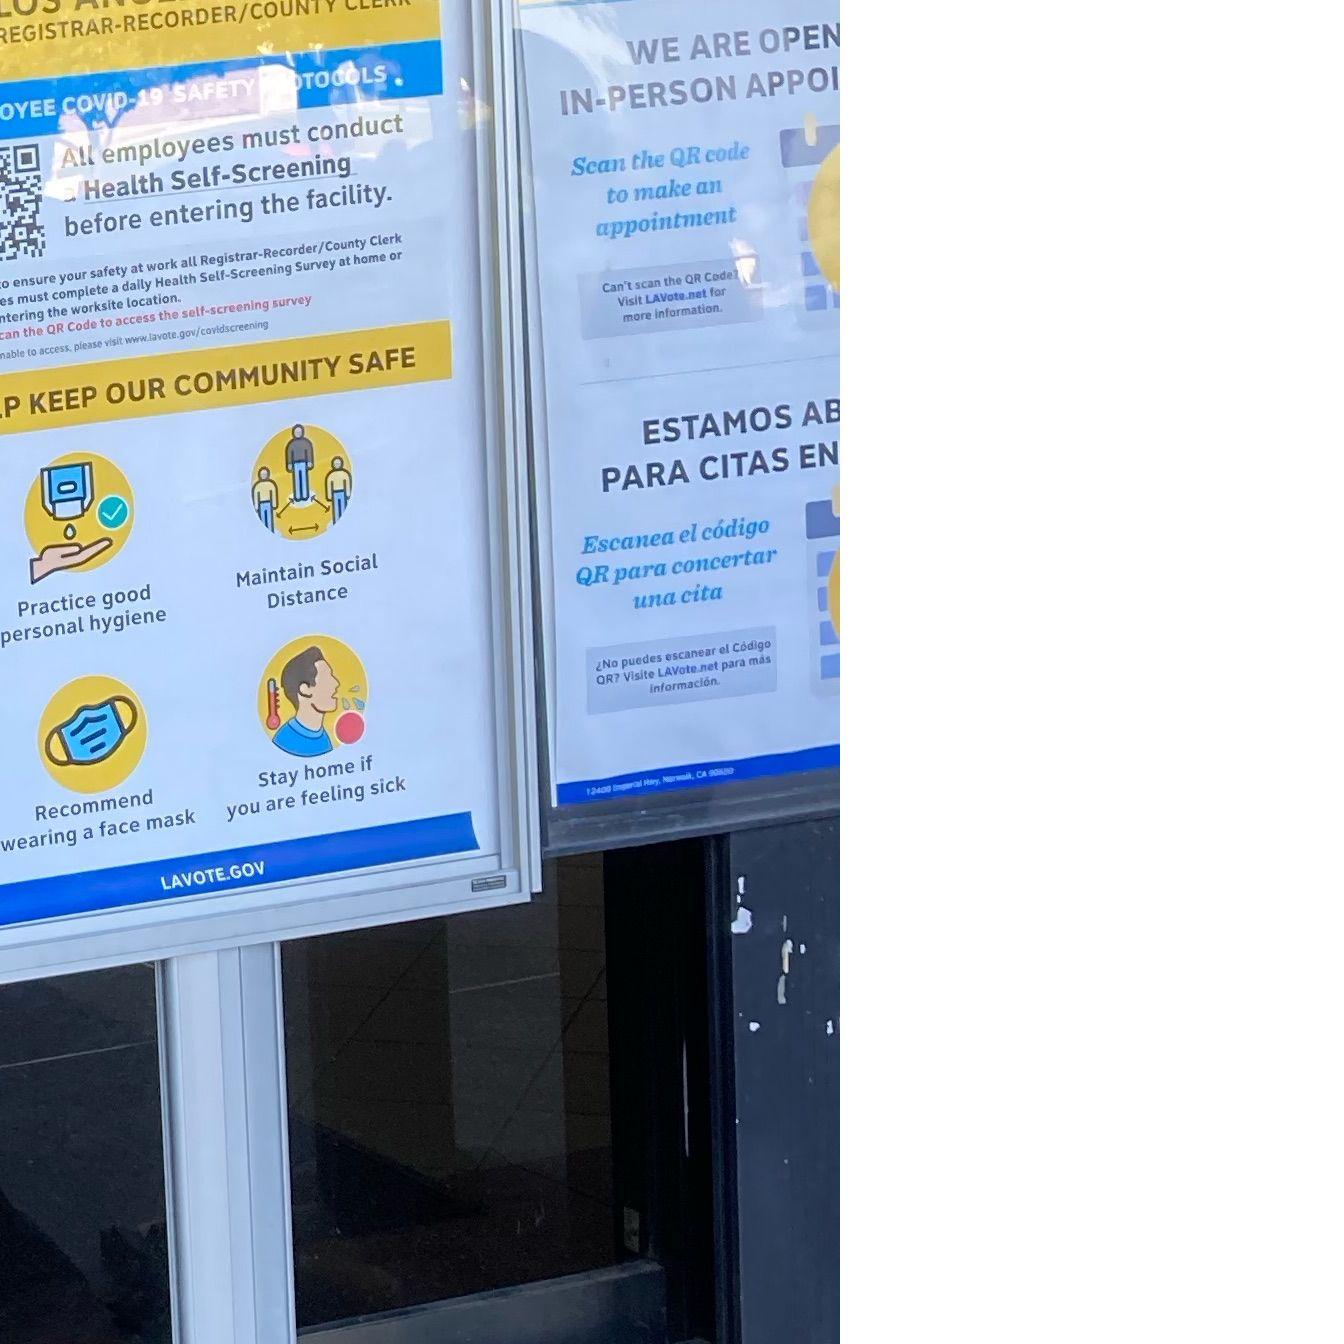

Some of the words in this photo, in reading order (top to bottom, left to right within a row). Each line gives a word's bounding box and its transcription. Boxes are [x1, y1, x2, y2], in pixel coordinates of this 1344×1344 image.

[626, 37, 679, 64] WE
[690, 31, 750, 59] ARE
[759, 22, 839, 53] OPEN
[62, 88, 162, 114] COVID-19
[173, 79, 255, 103] SAFETY
[560, 74, 736, 115] IN-PERSON
[61, 144, 94, 168] All
[102, 135, 234, 166] employees
[242, 124, 300, 149] must
[307, 114, 403, 142] conduct
[570, 156, 625, 176] Scan
[631, 149, 664, 169] the
[670, 146, 700, 168] QR
[704, 141, 749, 162] code
[84, 171, 163, 203] Health
[170, 154, 353, 192] Self-Screening
[606, 187, 628, 204] to
[633, 178, 691, 201] make
[695, 179, 722, 194] an
[64, 211, 141, 236] before
[149, 198, 253, 226] entering
[260, 192, 299, 214] the
[305, 183, 392, 209] facility.
[596, 206, 736, 239] appointment
[12, 274, 56, 287] ensure
[58, 271, 87, 285] your
[89, 265, 127, 278] safety
[130, 262, 143, 273] at
[146, 258, 177, 271] work
[180, 255, 197, 268] all
[200, 238, 366, 266] Registrar-Recorder/County
[369, 232, 401, 246] Clerk
[17, 291, 49, 304] must
[51, 284, 108, 300] complete
[111, 284, 118, 292] a
[121, 278, 151, 292] daily
[155, 272, 196, 287] Health
[199, 263, 292, 282] Self-Screening
[294, 259, 335, 271] Survey
[338, 256, 350, 266] at
[353, 253, 386, 264] home
[389, 251, 402, 260] or
[22, 320, 43, 337] the
[46, 322, 64, 335] QR
[67, 318, 97, 332] Code
[99, 318, 112, 328] to
[115, 313, 156, 326] access
[158, 309, 179, 320] the
[181, 299, 269, 318] self-screening
[272, 295, 312, 308] survey
[46, 306, 67, 318] the
[70, 299, 123, 314] worksite
[126, 293, 181, 308] location.
[29, 385, 97, 415] KEEP
[105, 377, 166, 404] OUR
[174, 355, 341, 396] COMMUNITY
[348, 346, 415, 374] SAFE
[642, 404, 792, 445] ESTAMOS
[601, 459, 689, 492] PARA
[699, 447, 789, 480] CITAS
[799, 440, 838, 469] EN
[581, 531, 674, 554] Escanea
[679, 523, 697, 543] el
[701, 517, 769, 540] código
[236, 562, 314, 587] Maintain
[320, 552, 377, 575] Social
[575, 564, 609, 586] QR
[612, 563, 666, 585] para
[671, 549, 777, 574] concertar
[17, 593, 95, 617] Practice
[102, 583, 150, 611] good
[267, 586, 347, 608] Distance
[632, 591, 676, 609] una
[680, 583, 722, 603] cita
[0, 616, 84, 648] personal
[89, 609, 166, 634] hygiene
[258, 769, 298, 787] Stay
[304, 761, 354, 780] home
[360, 754, 372, 771] if
[35, 788, 152, 821] Recommend
[226, 801, 259, 822] you
[266, 796, 295, 811] are
[300, 784, 364, 805] feeling
[370, 775, 405, 795] sick
[0, 828, 76, 851] wearing
[83, 827, 93, 839] a
[98, 820, 139, 837] face
[146, 808, 195, 830] mask
[160, 860, 264, 889] LAVOTE.GOV
